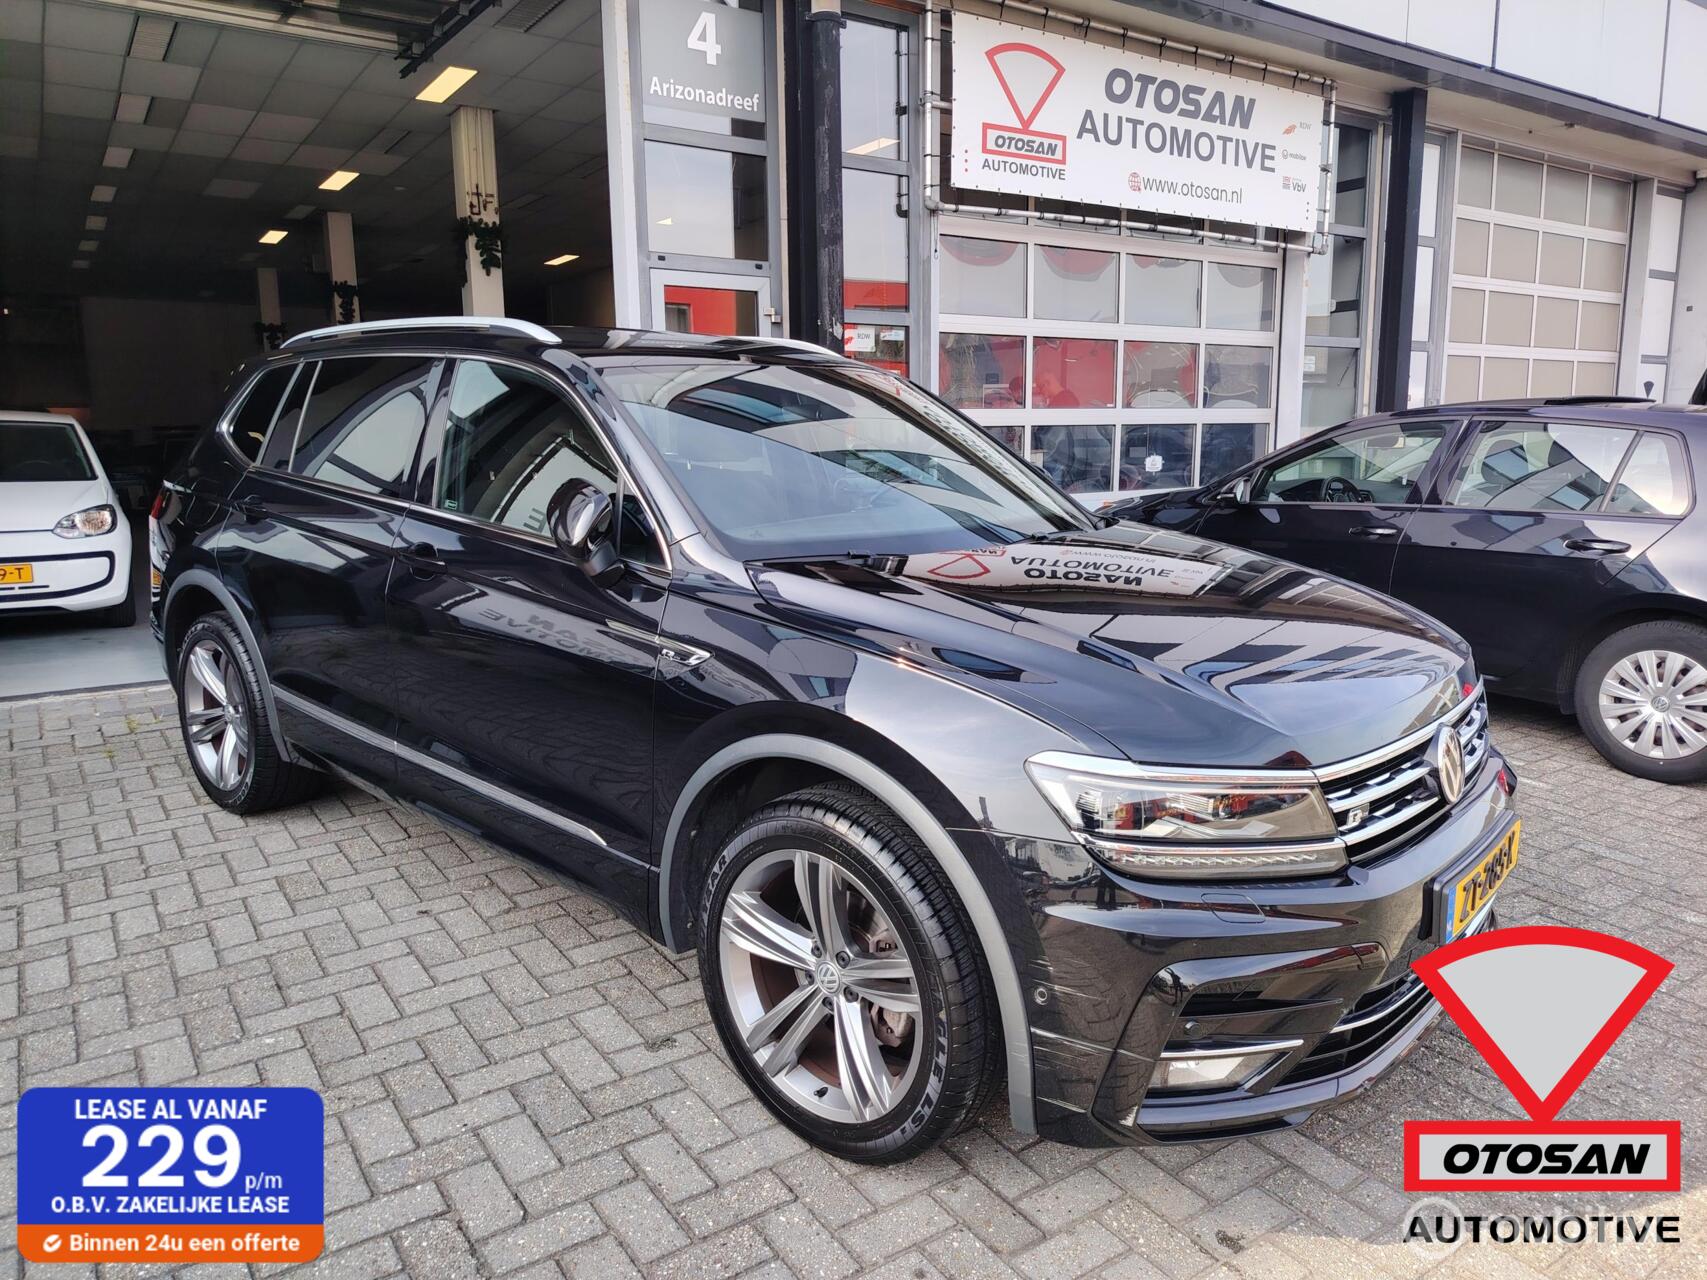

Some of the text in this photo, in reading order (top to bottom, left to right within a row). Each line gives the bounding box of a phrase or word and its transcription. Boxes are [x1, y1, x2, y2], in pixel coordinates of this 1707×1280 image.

[687, 12, 722, 65] 4
[649, 76, 760, 112] Arizonadreef
[1104, 67, 1256, 129] OTOSAN
[994, 135, 1058, 157] OTOSAN
[1076, 109, 1277, 173] AUTOMOTIVE
[981, 158, 1066, 181] AUTOMOTIVE
[1142, 176, 1243, 204] www.otosan.nl
